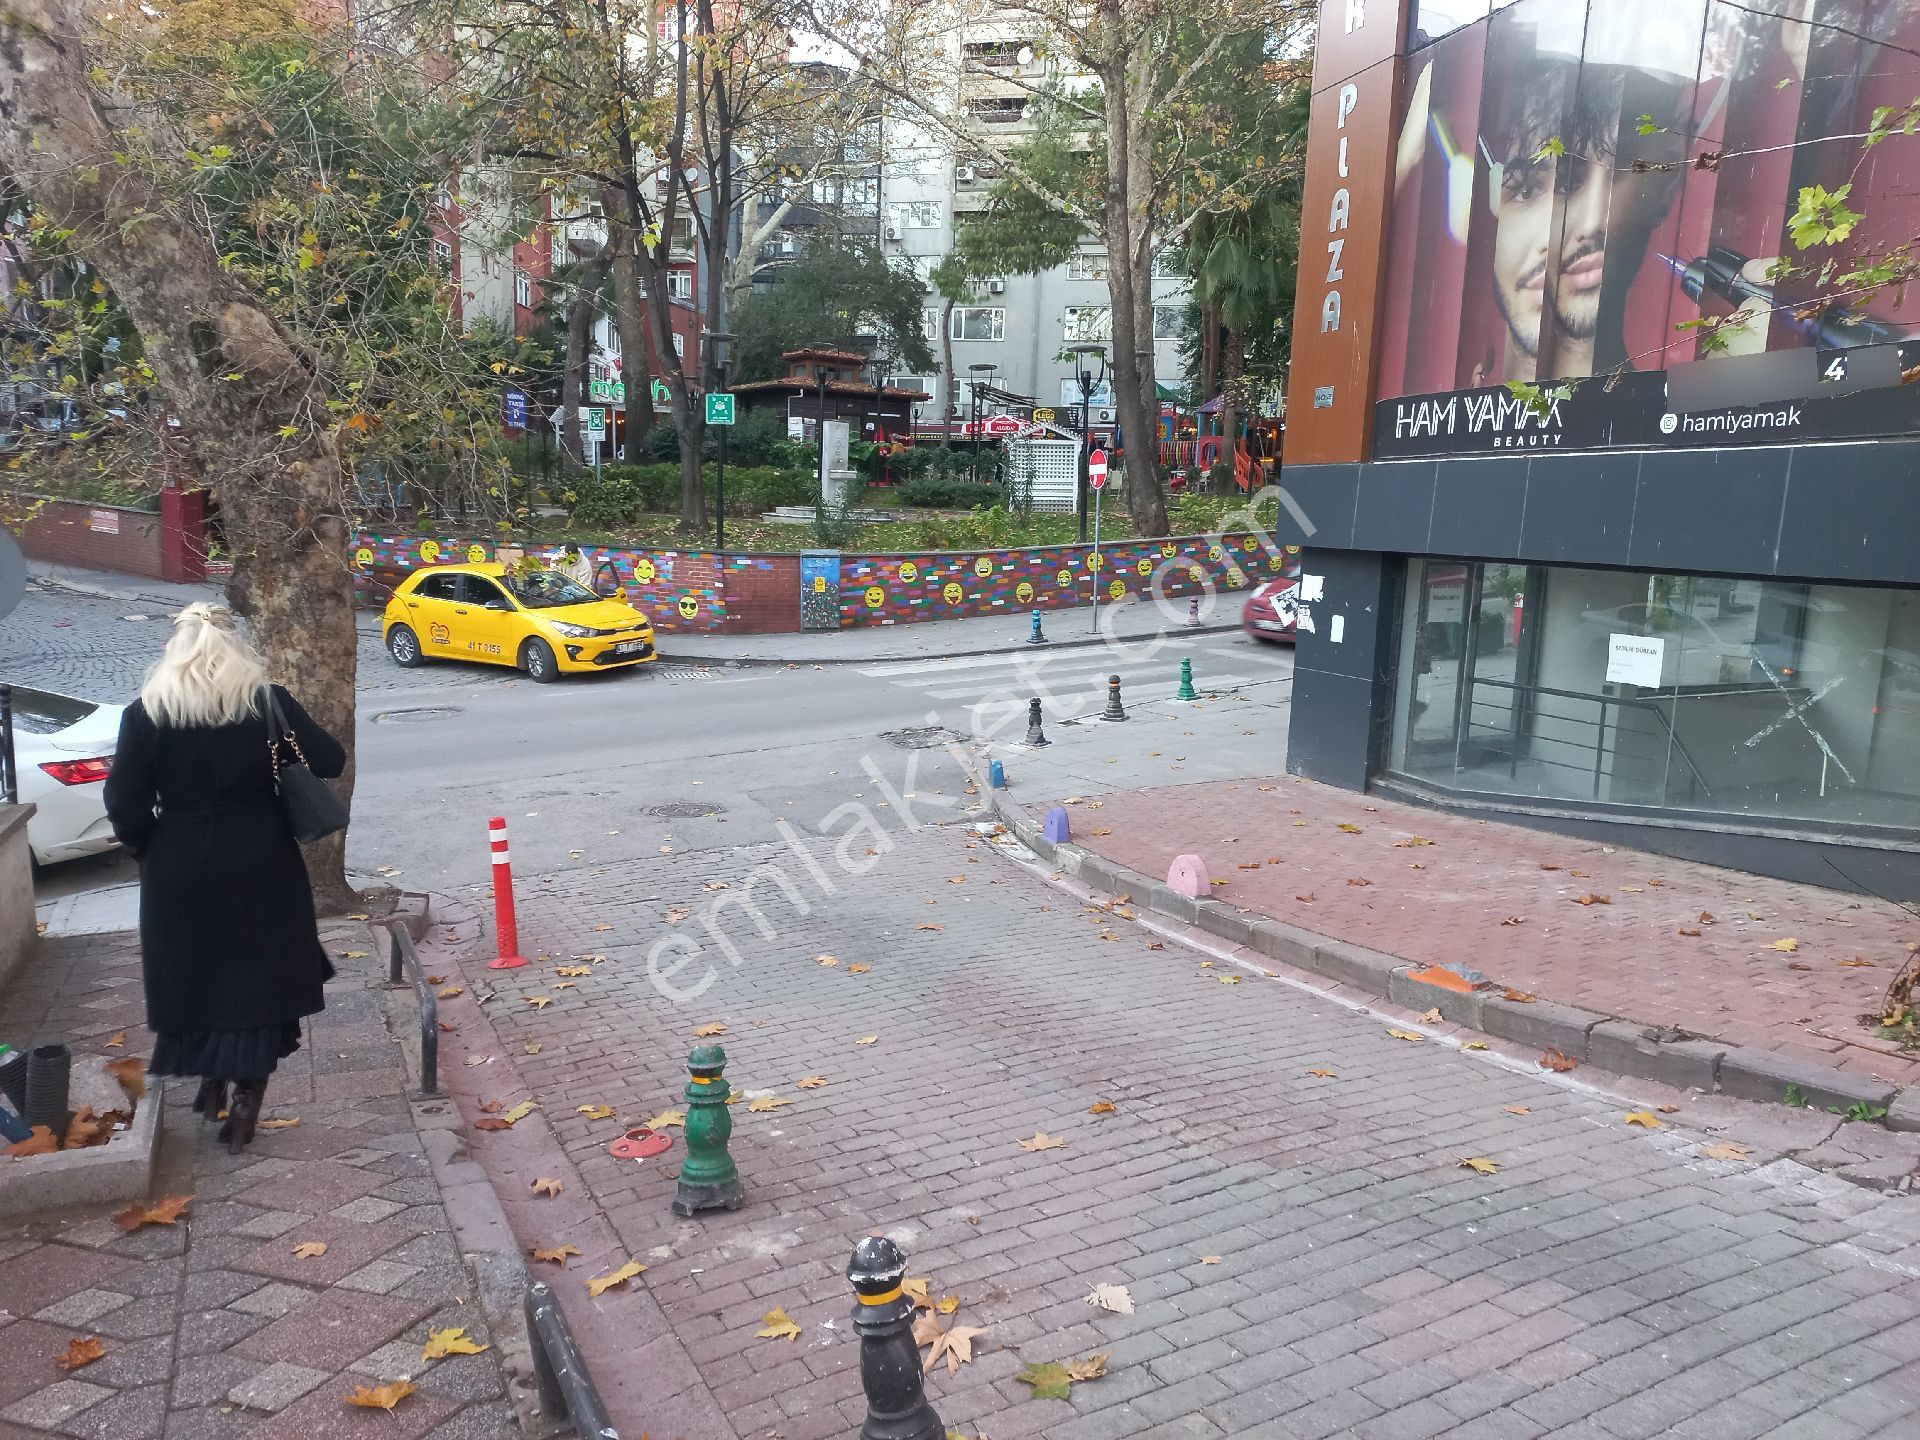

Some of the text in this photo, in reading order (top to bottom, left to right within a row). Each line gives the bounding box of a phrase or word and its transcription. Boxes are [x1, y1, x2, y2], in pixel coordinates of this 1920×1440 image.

[1321, 83, 1358, 334] PLAZA
[1682, 405, 1801, 434] hamiyamak
[1493, 434, 1562, 447] BEAUTY
[468, 641, 475, 651] 41
[478, 642, 482, 651] T
